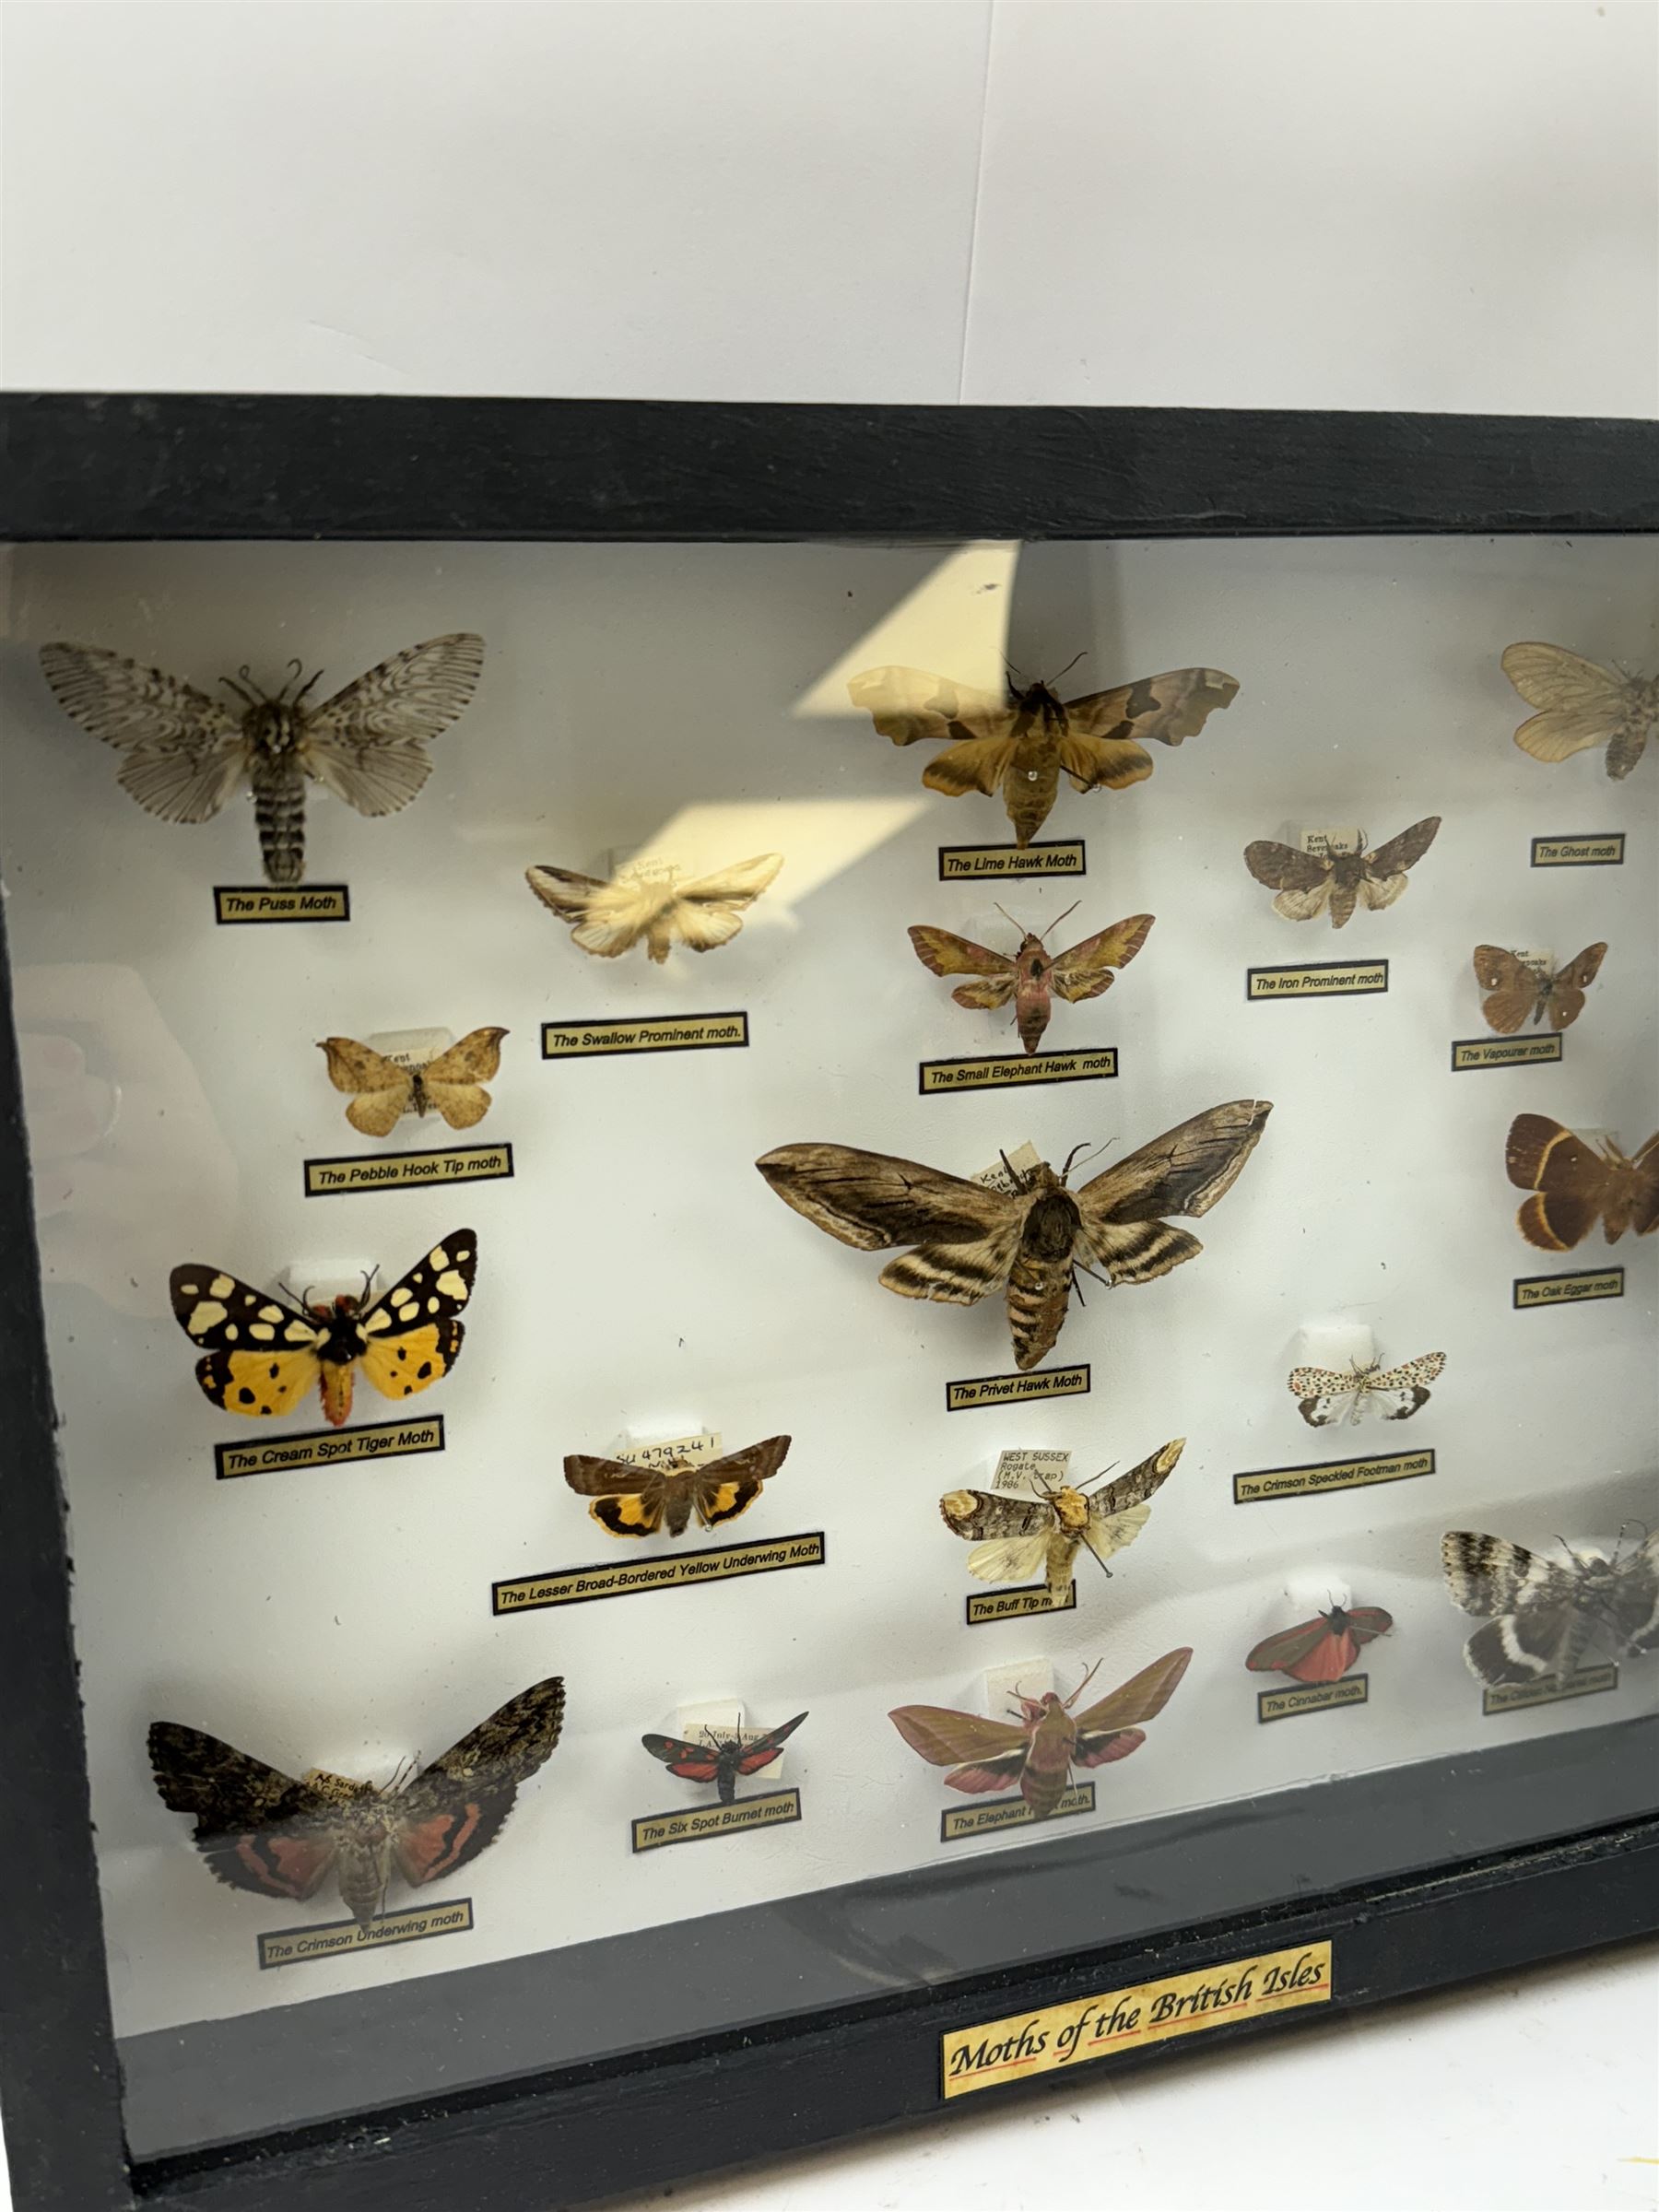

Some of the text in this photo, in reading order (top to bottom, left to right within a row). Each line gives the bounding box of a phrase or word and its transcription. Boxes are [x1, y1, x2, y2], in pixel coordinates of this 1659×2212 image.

[1539, 844, 1615, 857] The Ghost moth
[947, 853, 1077, 872] The Lime Hawk Moth
[227, 896, 336, 912] The Puss Moth
[1256, 972, 1383, 990] The Iron Prominent moth
[554, 1026, 741, 1047] The Swallow Prominent moth.
[1461, 1042, 1555, 1062] The Vapourer moth
[931, 1056, 1111, 1084] The Small Elephant Hawk moth
[320, 1156, 500, 1184] The Pebble Hook Tip moth
[1522, 1279, 1618, 1300] The Oak Eggar moth
[954, 1374, 1082, 1400] The Privet Hawk Moth
[229, 1430, 434, 1469] The Cream Spot Tiger Moth
[1003, 1452, 1069, 1462] WEST SUSSEX
[1000, 1462, 1036, 1472] Rogate
[1241, 1458, 1428, 1496] The Crimson Speckled Footman moth
[995, 1480, 1019, 1489] 1986
[501, 1543, 819, 1605] The Lesser Broad-Bordered Yellow Underwing Moth
[973, 1604, 994, 1616] The
[996, 1598, 1021, 1612] Buff
[1021, 1597, 1040, 1610] Tip
[1266, 1685, 1362, 1712] The Cinnabar moth.
[642, 1828, 665, 1841] The
[668, 1822, 688, 1835] Six
[691, 1816, 720, 1831] Spot
[764, 1801, 794, 1817] moth
[953, 1818, 973, 1830] The
[976, 1808, 1026, 1825] Elephant
[267, 1911, 464, 1959] The Crimson Underwing moth
[950, 1952, 1326, 2076] Moths of the British Isles
